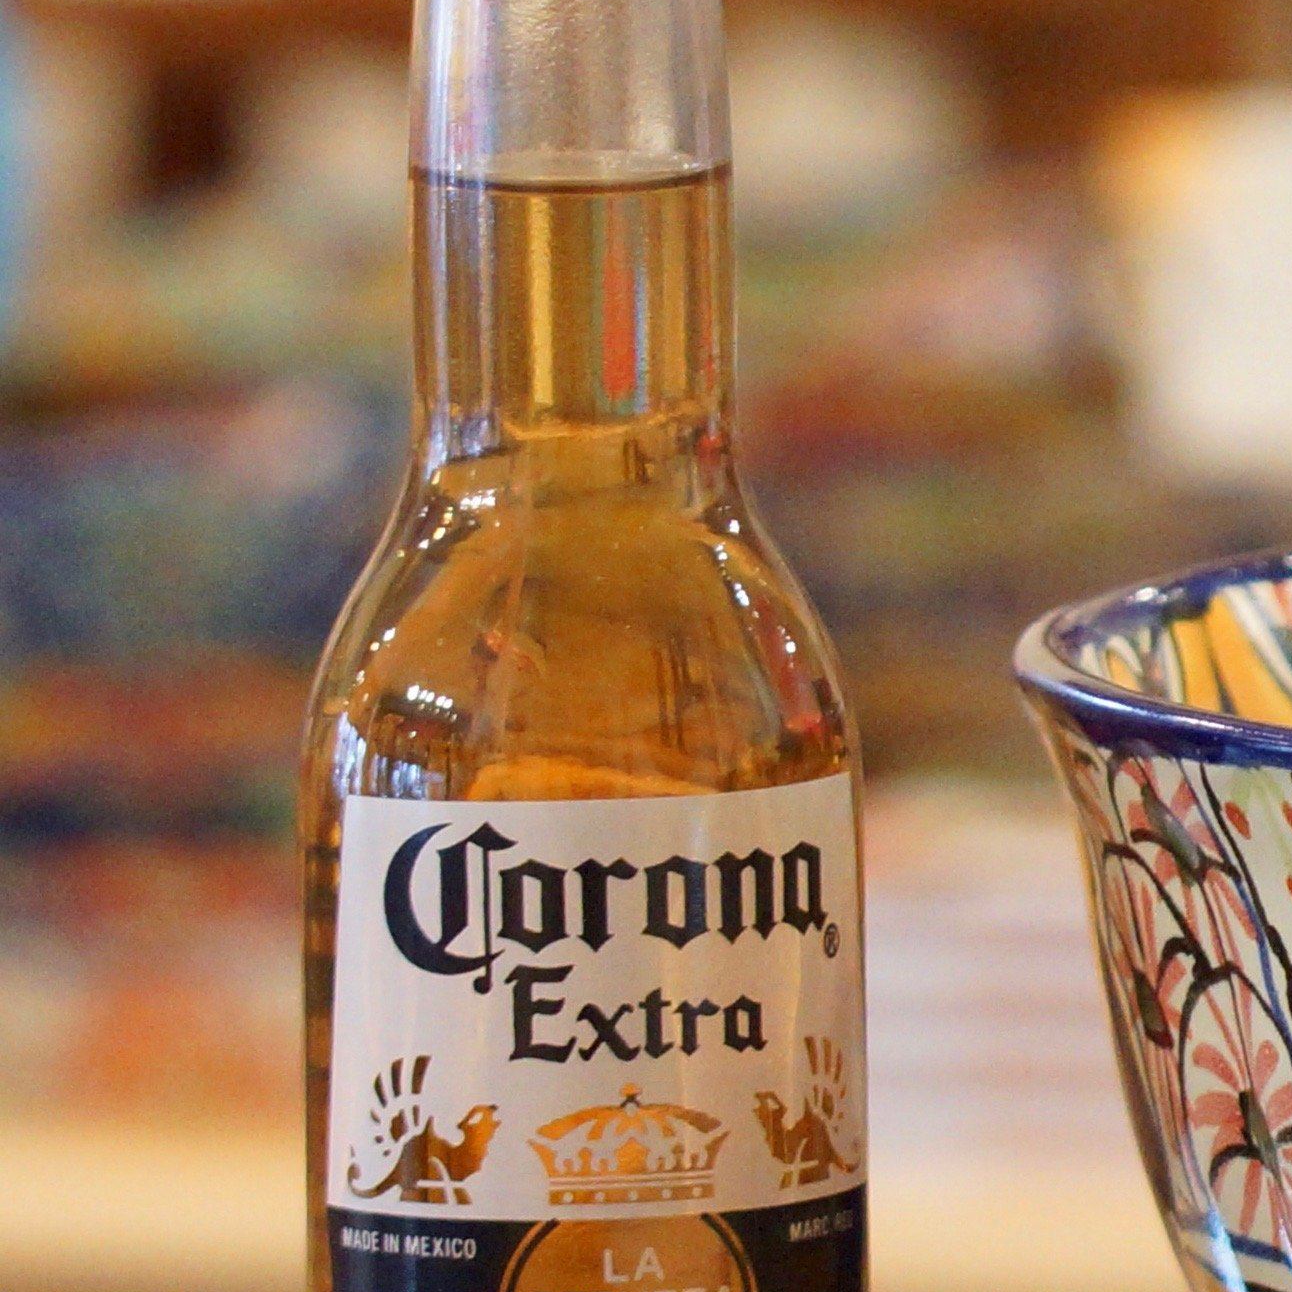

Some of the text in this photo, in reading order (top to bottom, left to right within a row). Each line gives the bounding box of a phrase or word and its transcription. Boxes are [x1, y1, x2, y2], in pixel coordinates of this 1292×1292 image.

[384, 822, 828, 995] Corona
[504, 964, 768, 1063] Extra
[341, 1226, 477, 1261] MADE IN MEXICO
[602, 1246, 665, 1284] LA
